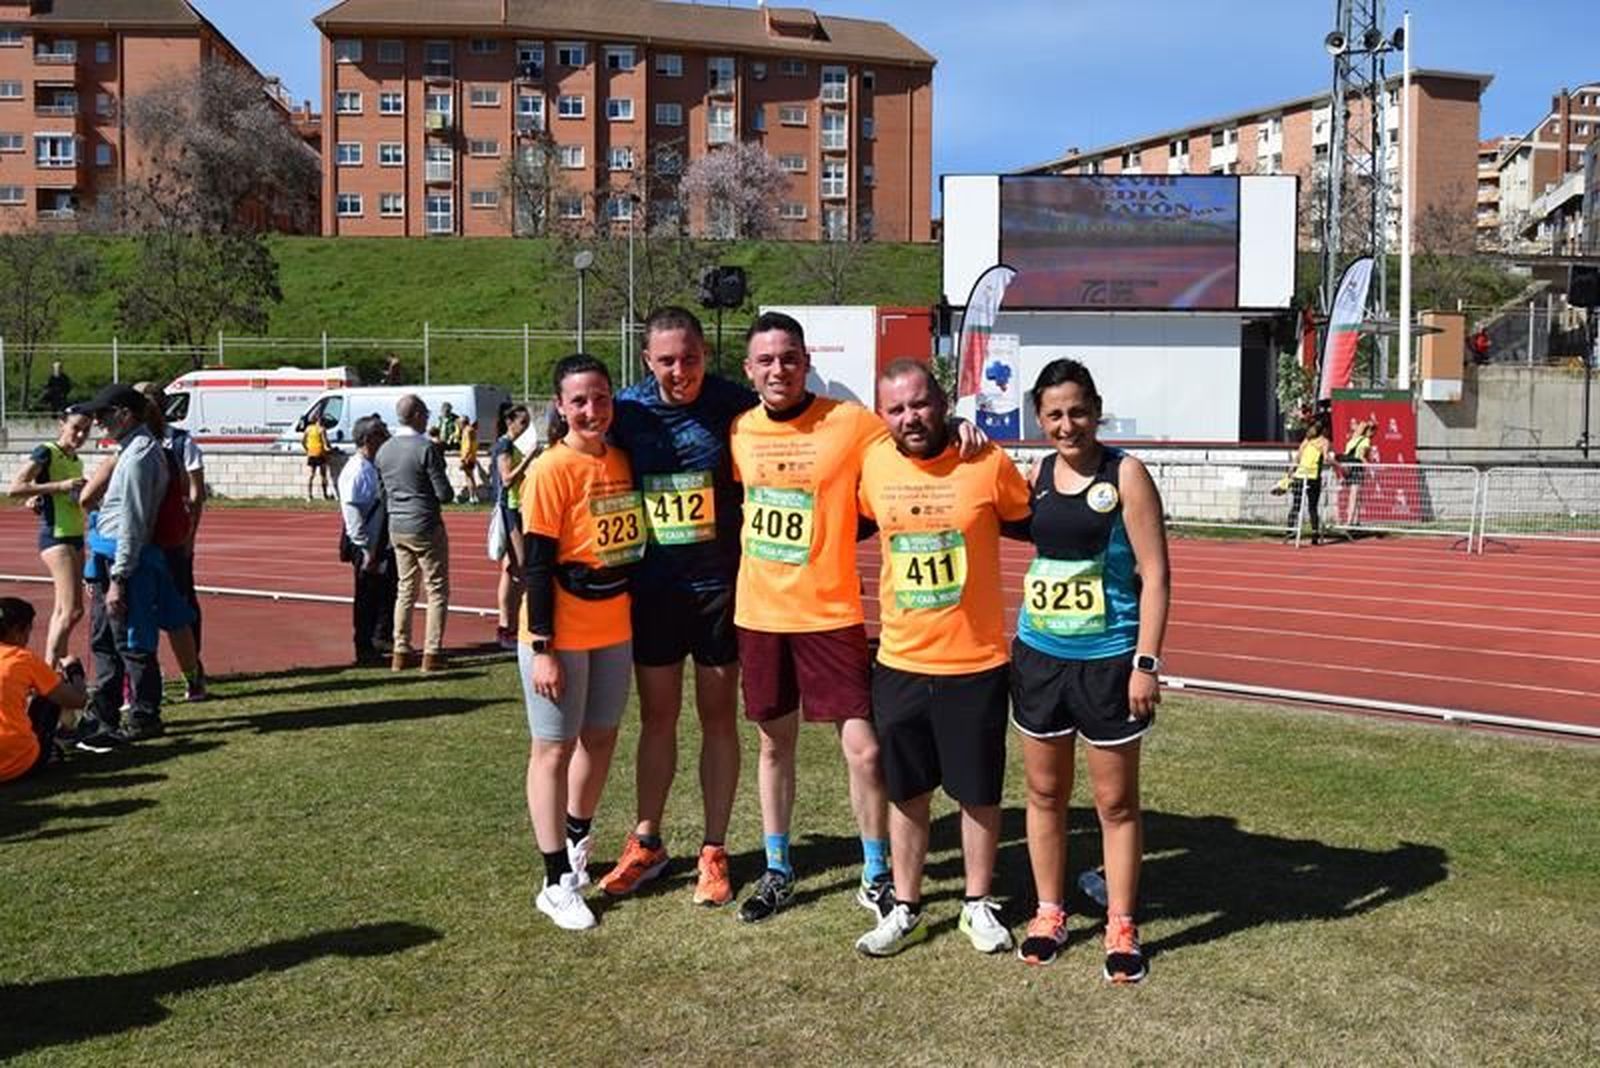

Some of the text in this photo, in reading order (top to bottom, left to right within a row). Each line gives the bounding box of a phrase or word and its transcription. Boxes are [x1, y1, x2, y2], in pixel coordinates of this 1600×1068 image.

[653, 493, 705, 523] 412
[751, 507, 804, 541] 408
[597, 513, 639, 547] 323
[906, 553, 955, 586] 411
[1032, 579, 1094, 610] 325
